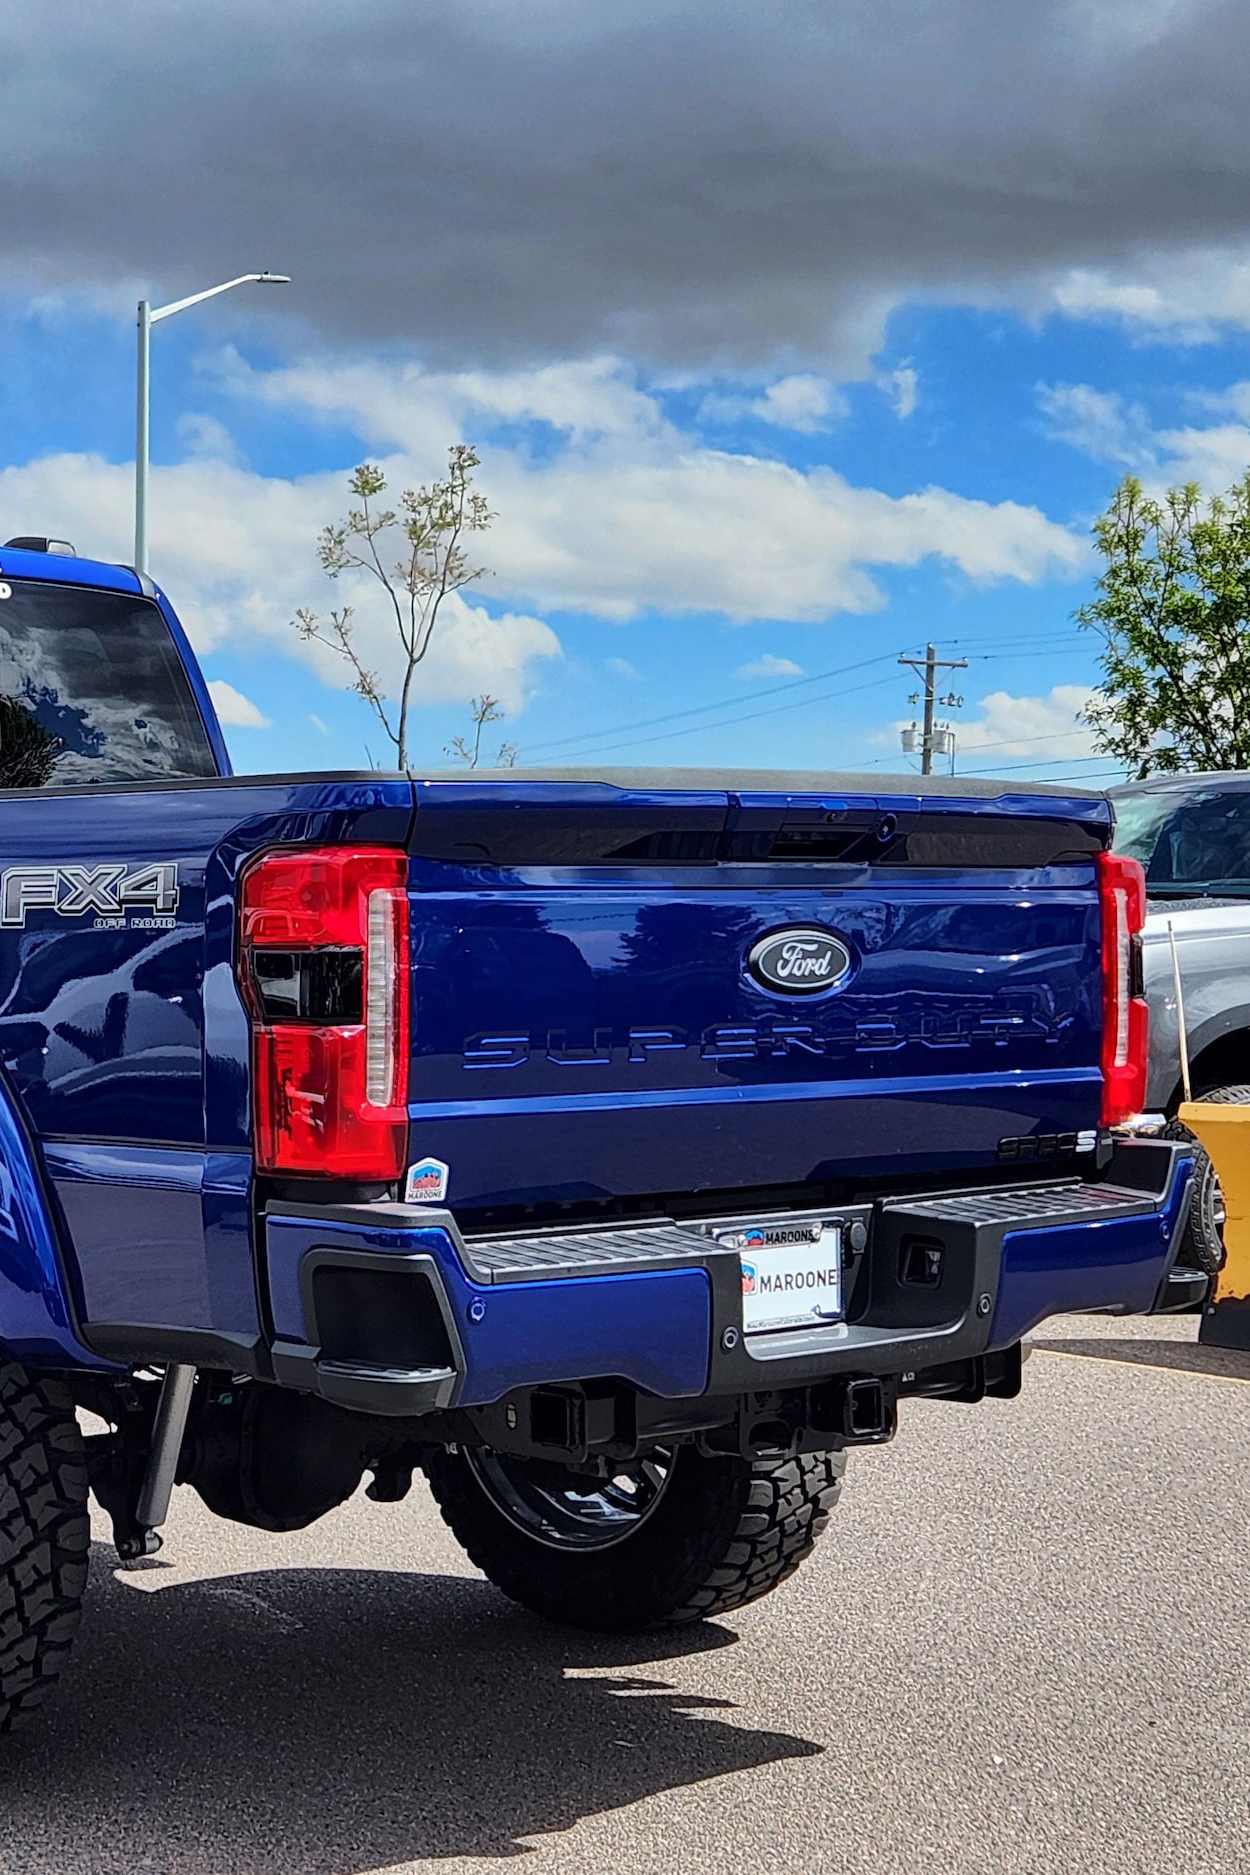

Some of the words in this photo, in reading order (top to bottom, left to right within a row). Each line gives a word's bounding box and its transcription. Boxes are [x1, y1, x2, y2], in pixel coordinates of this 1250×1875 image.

[0, 863, 180, 929] FX4
[93, 917, 126, 929] OFF
[131, 917, 176, 929] ROAD
[777, 942, 832, 977] Ford
[462, 1022, 826, 1069] SUPER
[854, 1011, 1075, 1052] DUTY
[408, 1191, 442, 1200] MAROONE
[759, 1269, 837, 1293] MAROONE
